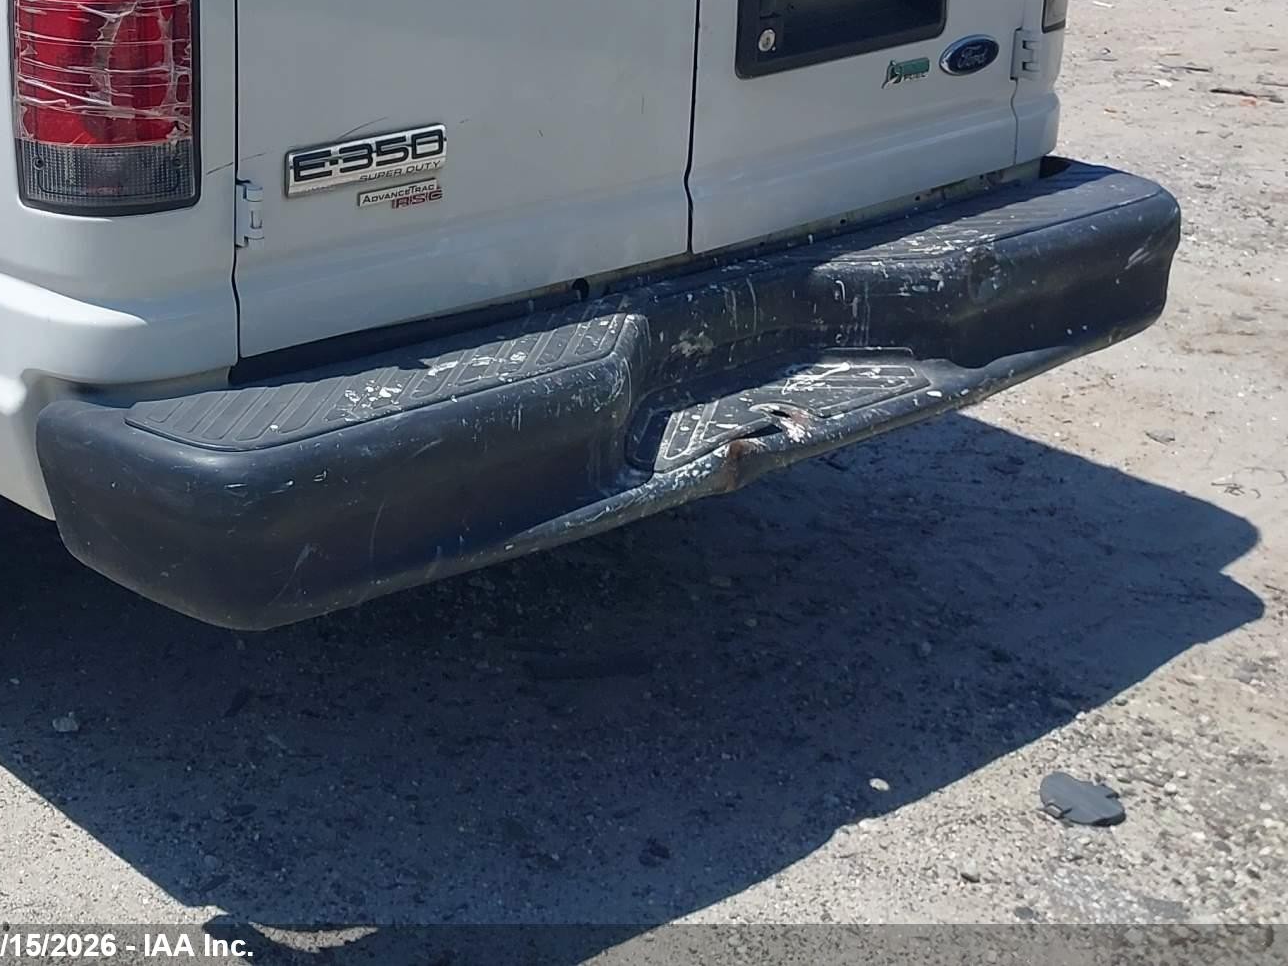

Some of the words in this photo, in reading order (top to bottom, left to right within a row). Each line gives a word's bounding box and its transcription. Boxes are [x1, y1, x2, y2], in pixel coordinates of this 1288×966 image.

[293, 129, 444, 182] E-350
[359, 168, 402, 182] SUPER
[406, 160, 441, 174] DUTY
